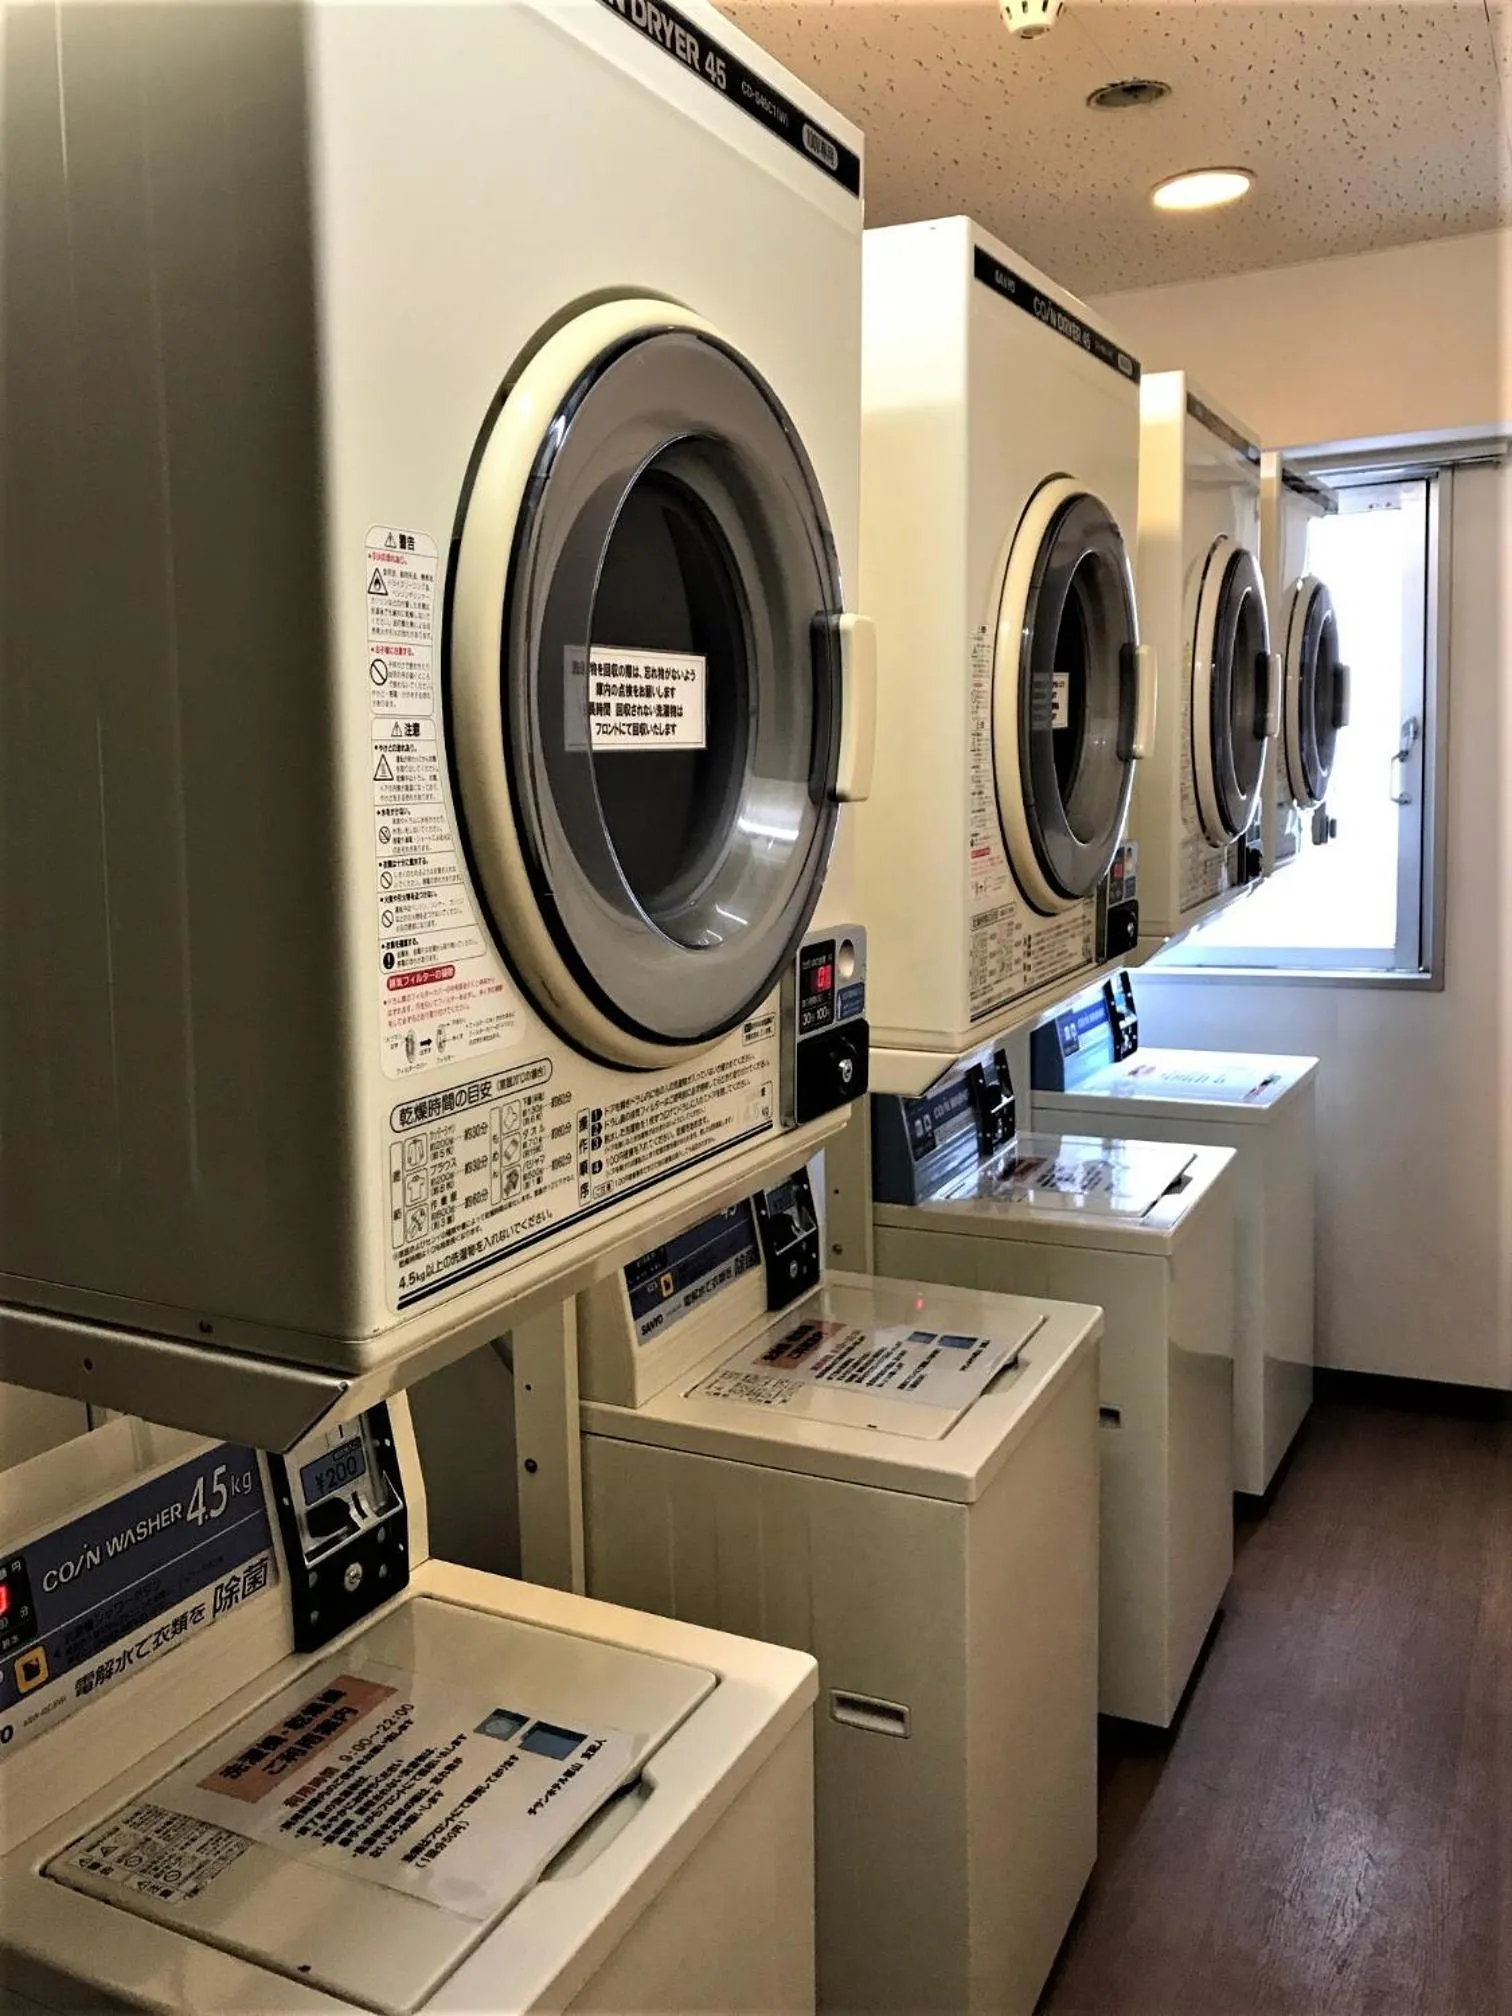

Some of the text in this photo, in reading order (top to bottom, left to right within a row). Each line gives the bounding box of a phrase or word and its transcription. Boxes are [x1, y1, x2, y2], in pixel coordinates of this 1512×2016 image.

[631, 0, 727, 90] DRYER 45
[596, 682, 676, 699] 庫内の点検をお願いします
[616, 703, 684, 718] 回収されない洗濯物は
[404, 722, 420, 738] 注意
[596, 722, 677, 737] フロントにて回収いたします
[399, 1080, 493, 1127] 乾燥時間の目安
[641, 1315, 663, 1336] SANYO
[315, 1454, 358, 1496] ¥200
[42, 1543, 100, 1592] COIN
[106, 1502, 183, 1558] WASHER
[75, 1602, 205, 1697] 電解水で衣類を
[212, 1557, 269, 1619] 除菌
[259, 1703, 361, 1777] ご利用案内
